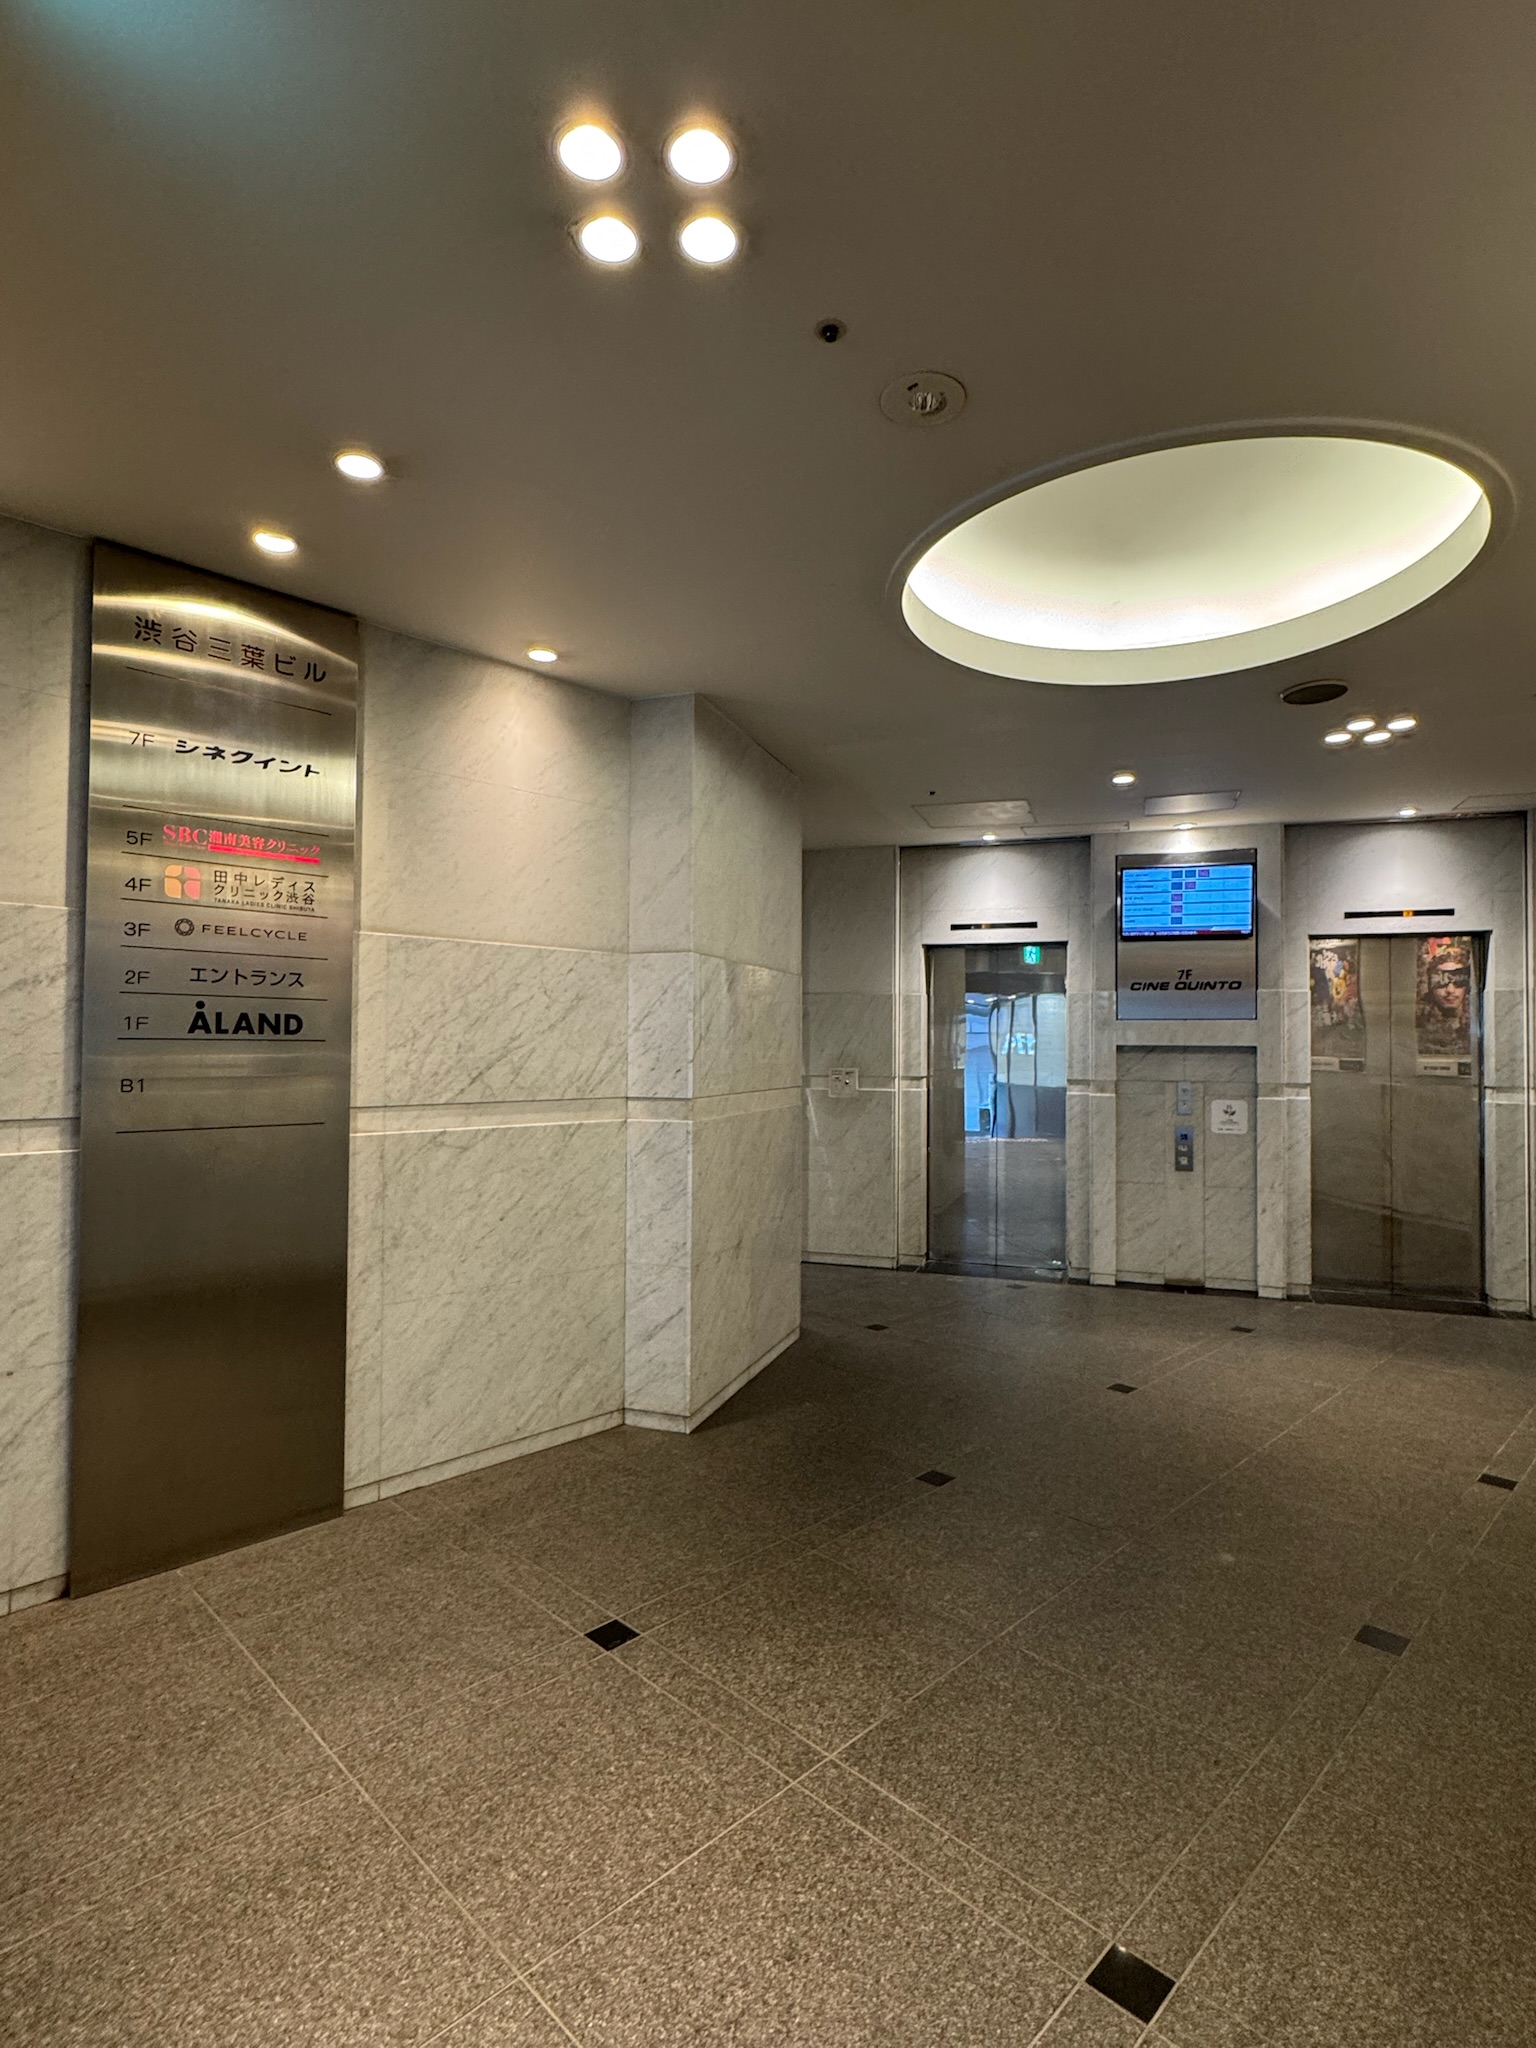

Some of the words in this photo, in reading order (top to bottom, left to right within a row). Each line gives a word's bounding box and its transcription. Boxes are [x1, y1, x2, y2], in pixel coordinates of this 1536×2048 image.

[134, 615, 327, 683] 渋谷三葉ビル
[128, 730, 155, 748] 7F
[175, 739, 321, 777] シネクイント
[126, 830, 153, 846] 5F
[125, 877, 152, 892] 4F
[214, 884, 316, 906] クリニック渋谷
[124, 922, 151, 937] 3F
[202, 924, 308, 942] FEELCYCLE
[124, 970, 150, 985] 2F
[190, 967, 305, 988] エントランス
[1177, 969, 1193, 981] 7F
[1130, 981, 1170, 991] CINE
[1174, 980, 1243, 991] QUINTO
[124, 1016, 149, 1031] 1F
[187, 1000, 304, 1036] ÅLAND
[120, 1078, 145, 1093] B1
